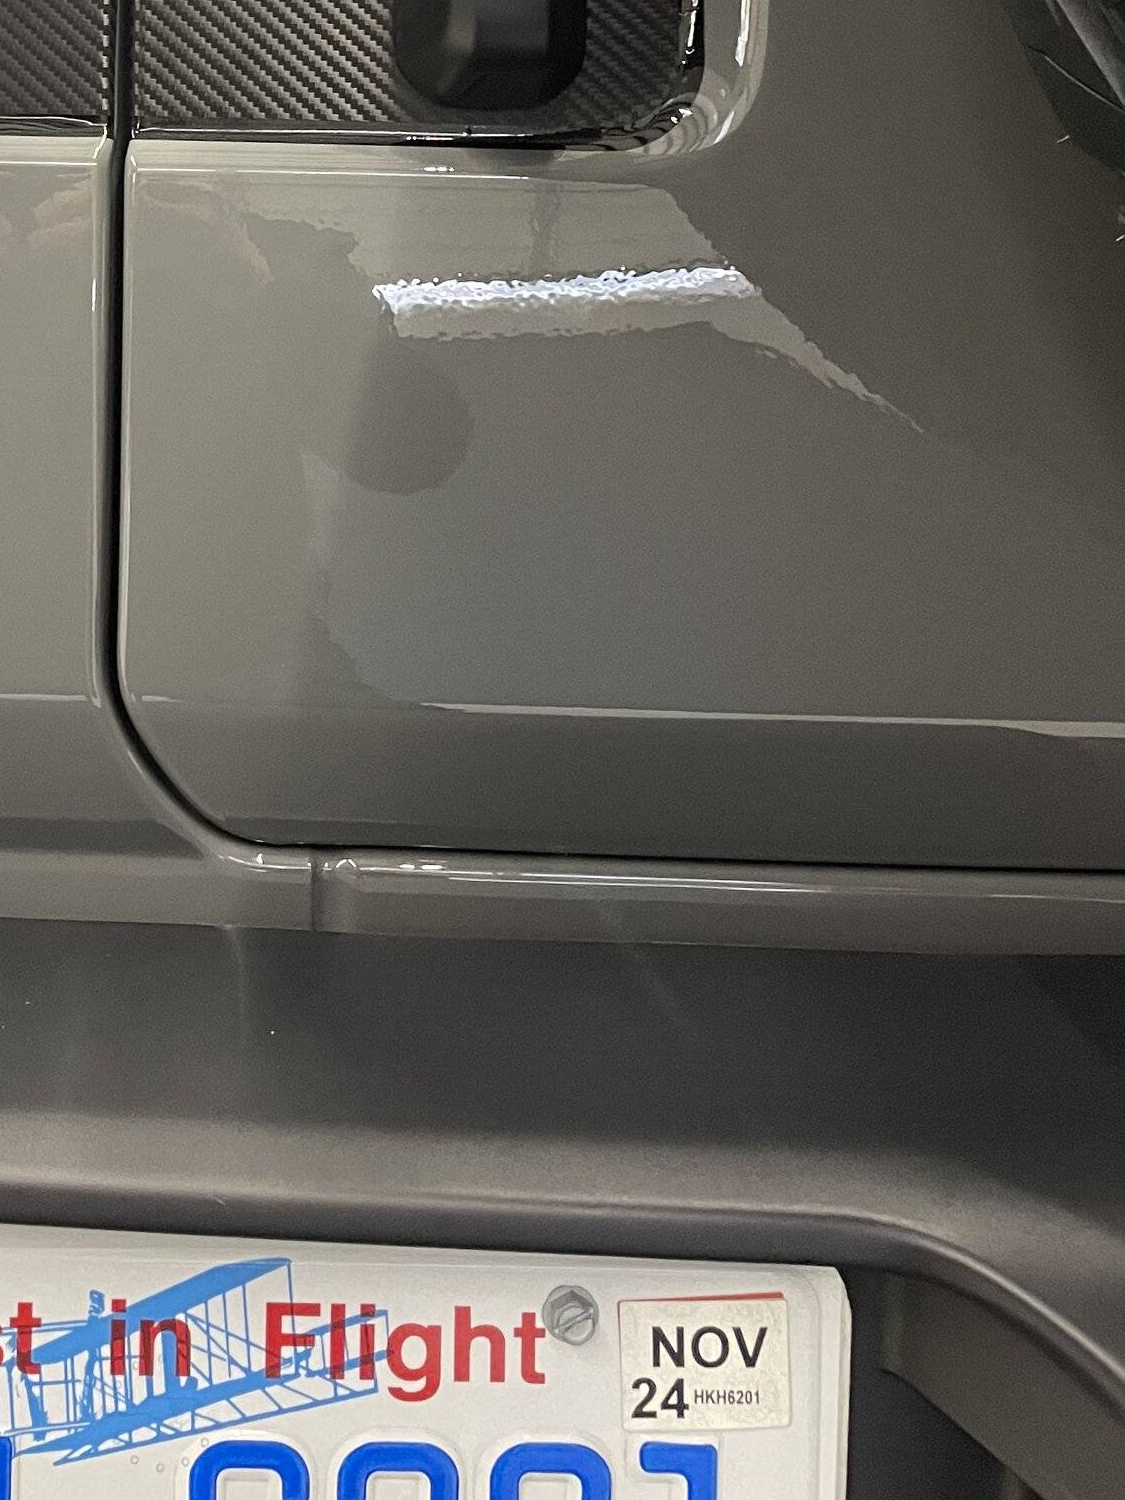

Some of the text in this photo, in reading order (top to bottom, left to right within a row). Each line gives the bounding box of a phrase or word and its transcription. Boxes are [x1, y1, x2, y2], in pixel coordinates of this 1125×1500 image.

[110, 1298, 192, 1377] in
[265, 1302, 546, 1402] Flight
[651, 1325, 768, 1368] NOV
[631, 1377, 760, 1419] 24 HKH6201
